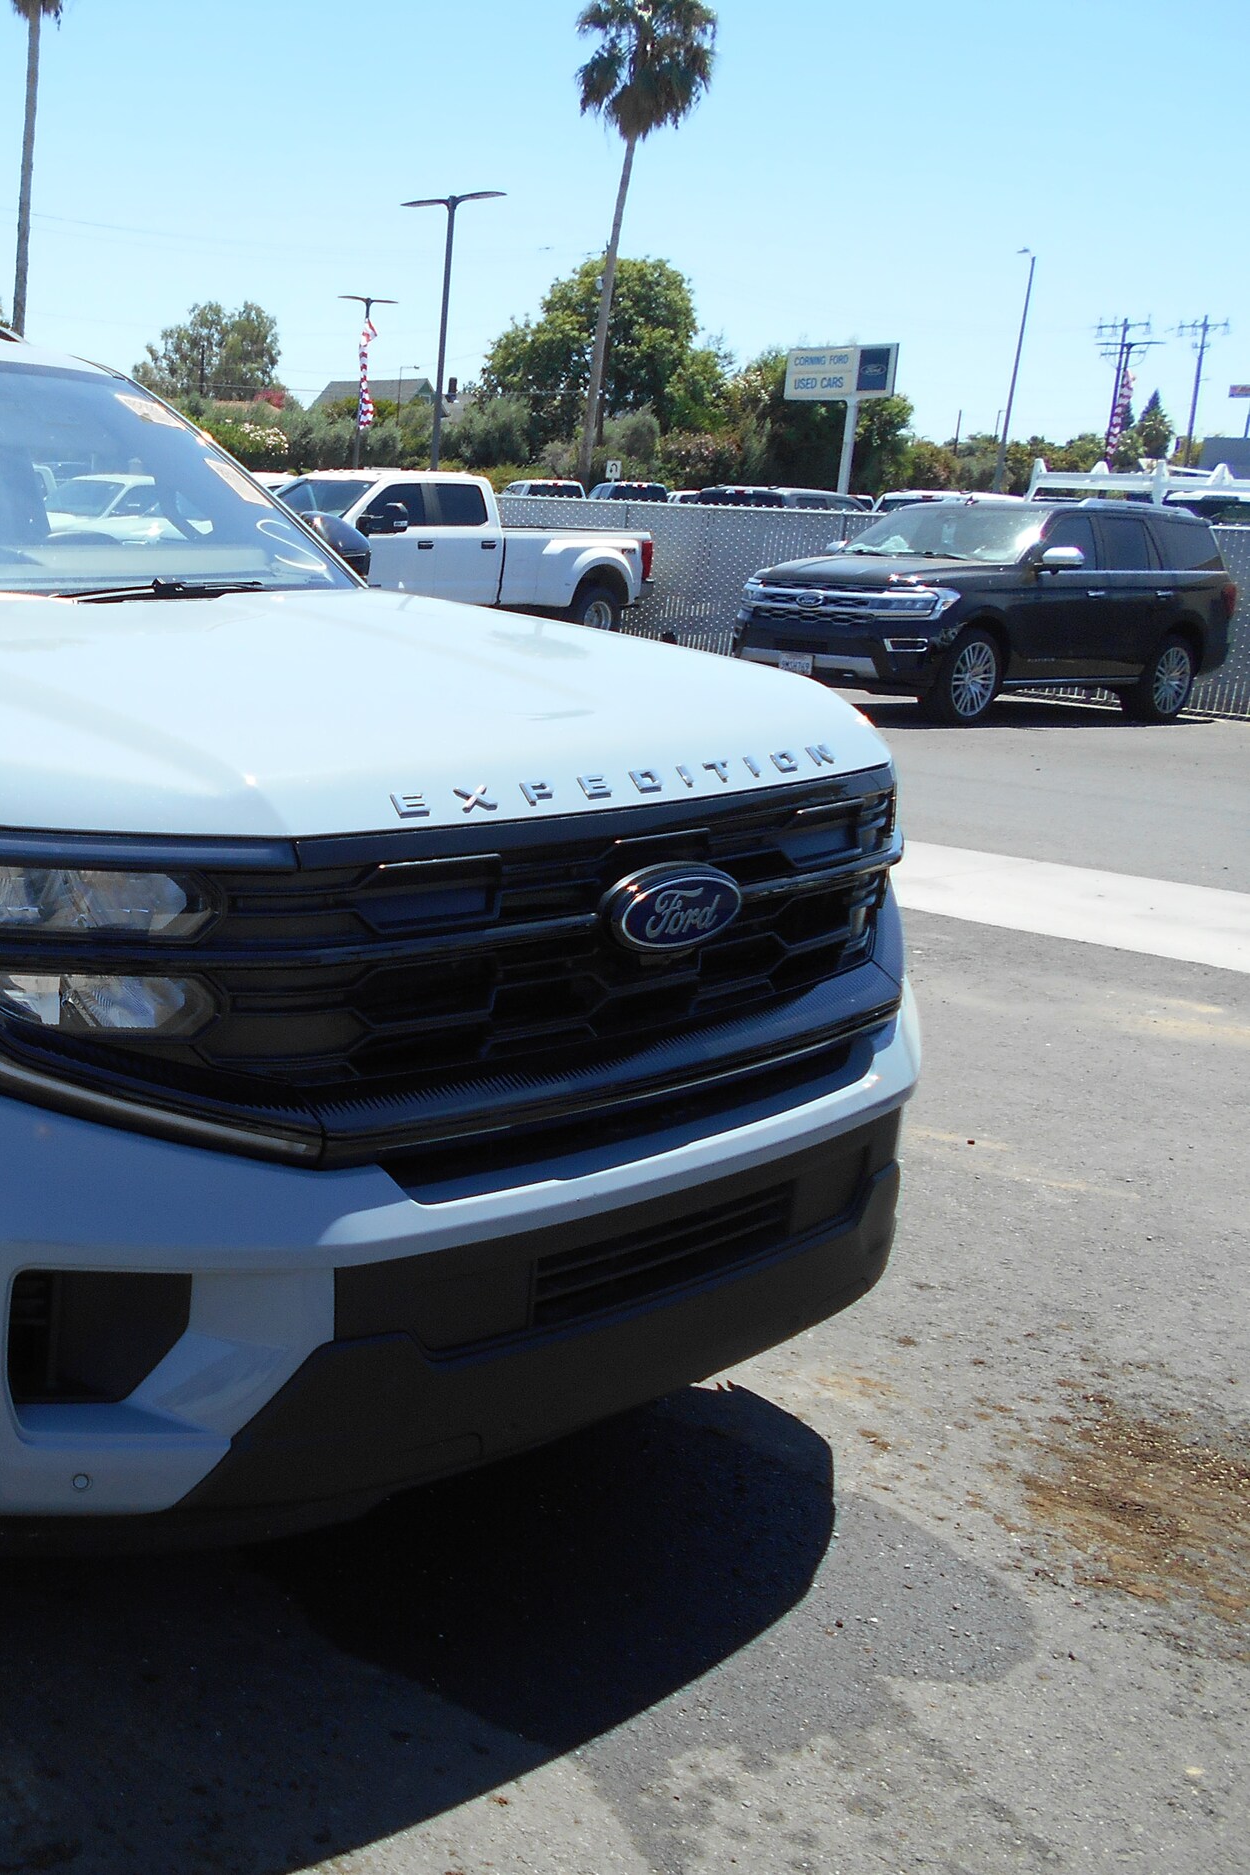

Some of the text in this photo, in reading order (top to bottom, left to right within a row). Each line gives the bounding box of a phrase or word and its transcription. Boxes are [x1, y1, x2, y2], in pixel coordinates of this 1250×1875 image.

[794, 354, 849, 367] CORNING FORD
[794, 377, 844, 390] USED CARS
[389, 742, 838, 819] EXPEDITION
[645, 887, 722, 939] Ford
